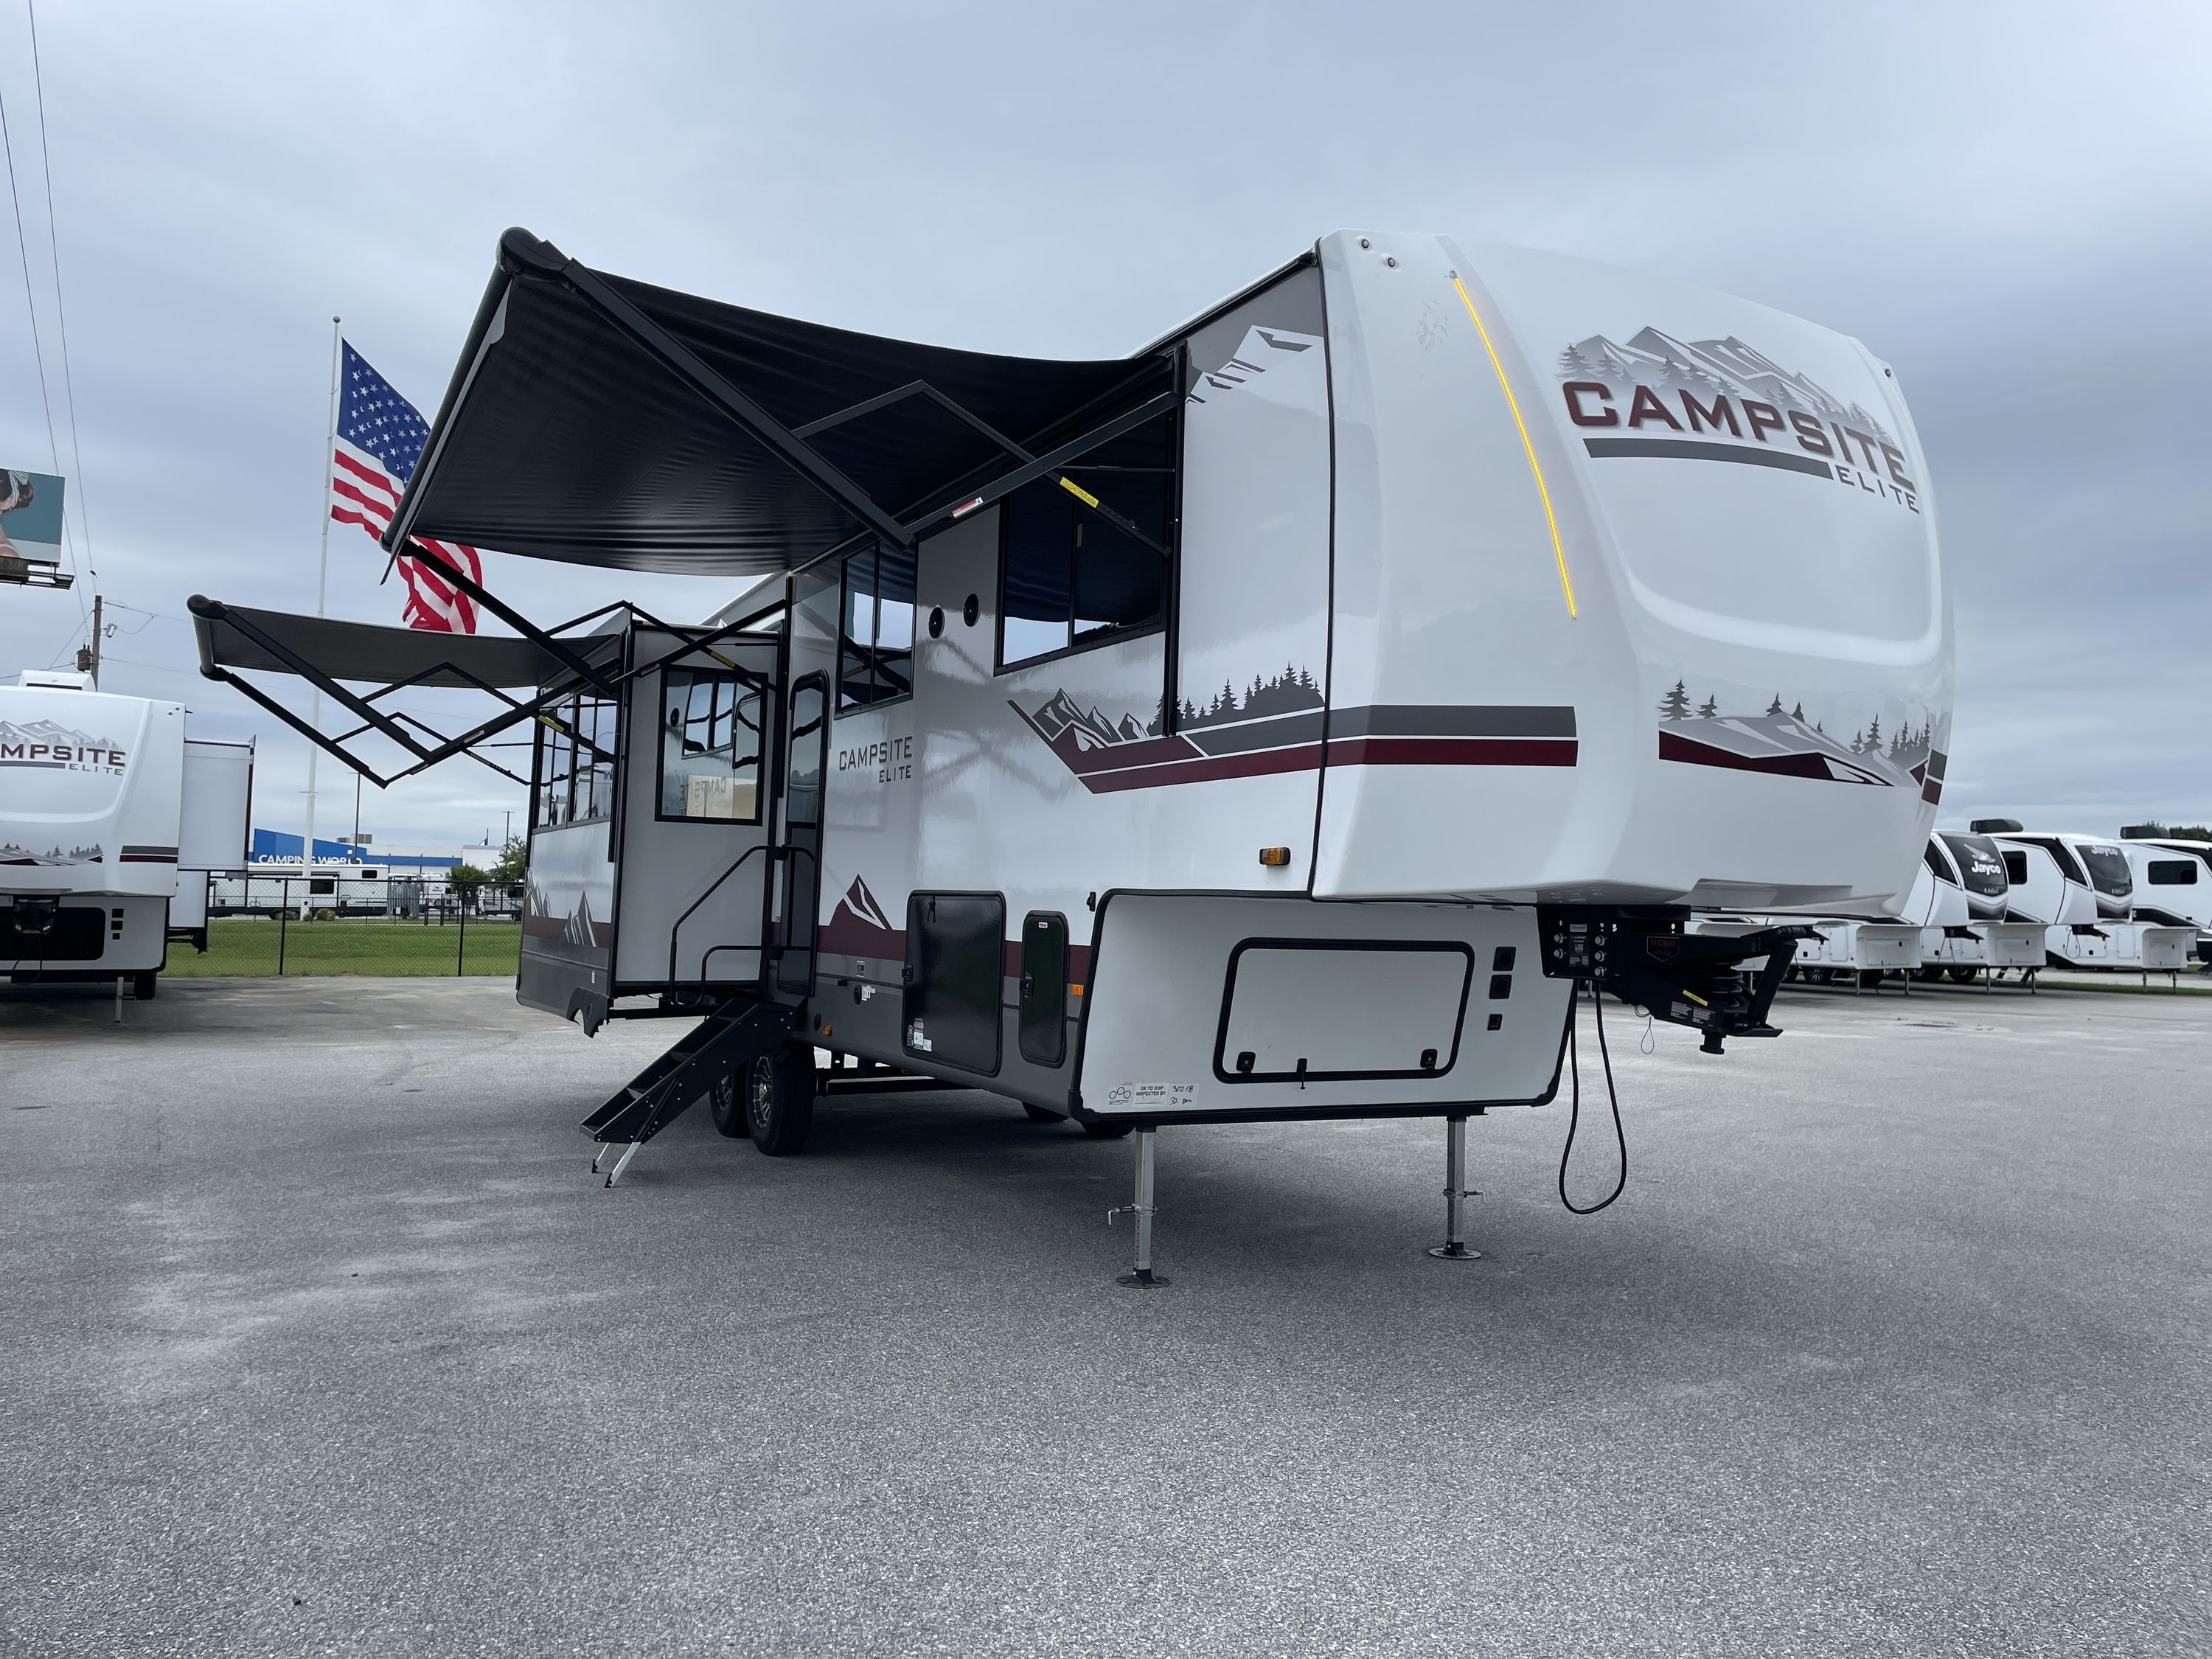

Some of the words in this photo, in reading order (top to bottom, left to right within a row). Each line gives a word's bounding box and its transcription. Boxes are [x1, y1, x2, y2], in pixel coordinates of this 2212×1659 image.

[1562, 380, 1916, 493] CAMPSITE
[1835, 464, 1920, 515] ELITE
[839, 736, 913, 771] CAMPSITE
[69, 763, 124, 776] ELITE
[878, 765, 912, 784] ELITE
[2092, 845, 2118, 857] Jayco
[1971, 860, 2001, 876] Jayco
